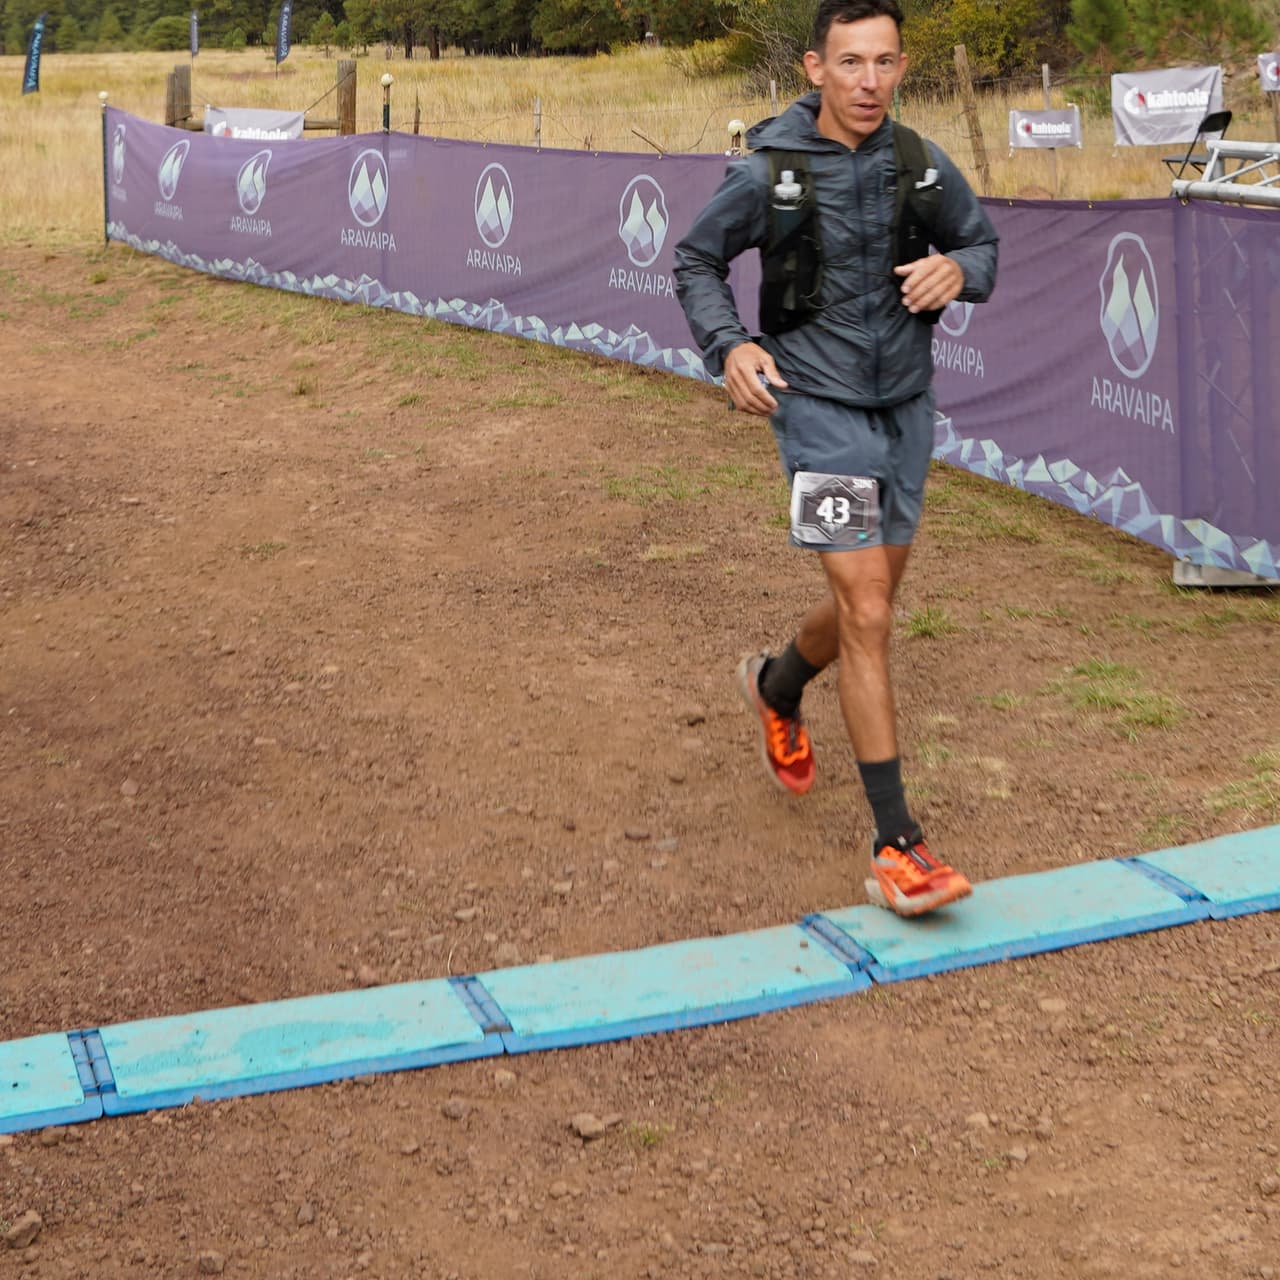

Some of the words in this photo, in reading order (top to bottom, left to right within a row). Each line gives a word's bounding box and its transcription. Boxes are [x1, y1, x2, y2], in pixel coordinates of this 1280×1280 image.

[230, 216, 272, 237] ARAVAIPA
[340, 226, 397, 252] ARAVAIPA
[466, 247, 522, 277] ARAVAIPA
[608, 267, 675, 299] ARAVAIPA
[931, 338, 984, 379] RAVAIPA
[1091, 376, 1175, 435] ARAVAIPA
[816, 496, 850, 524] 43
